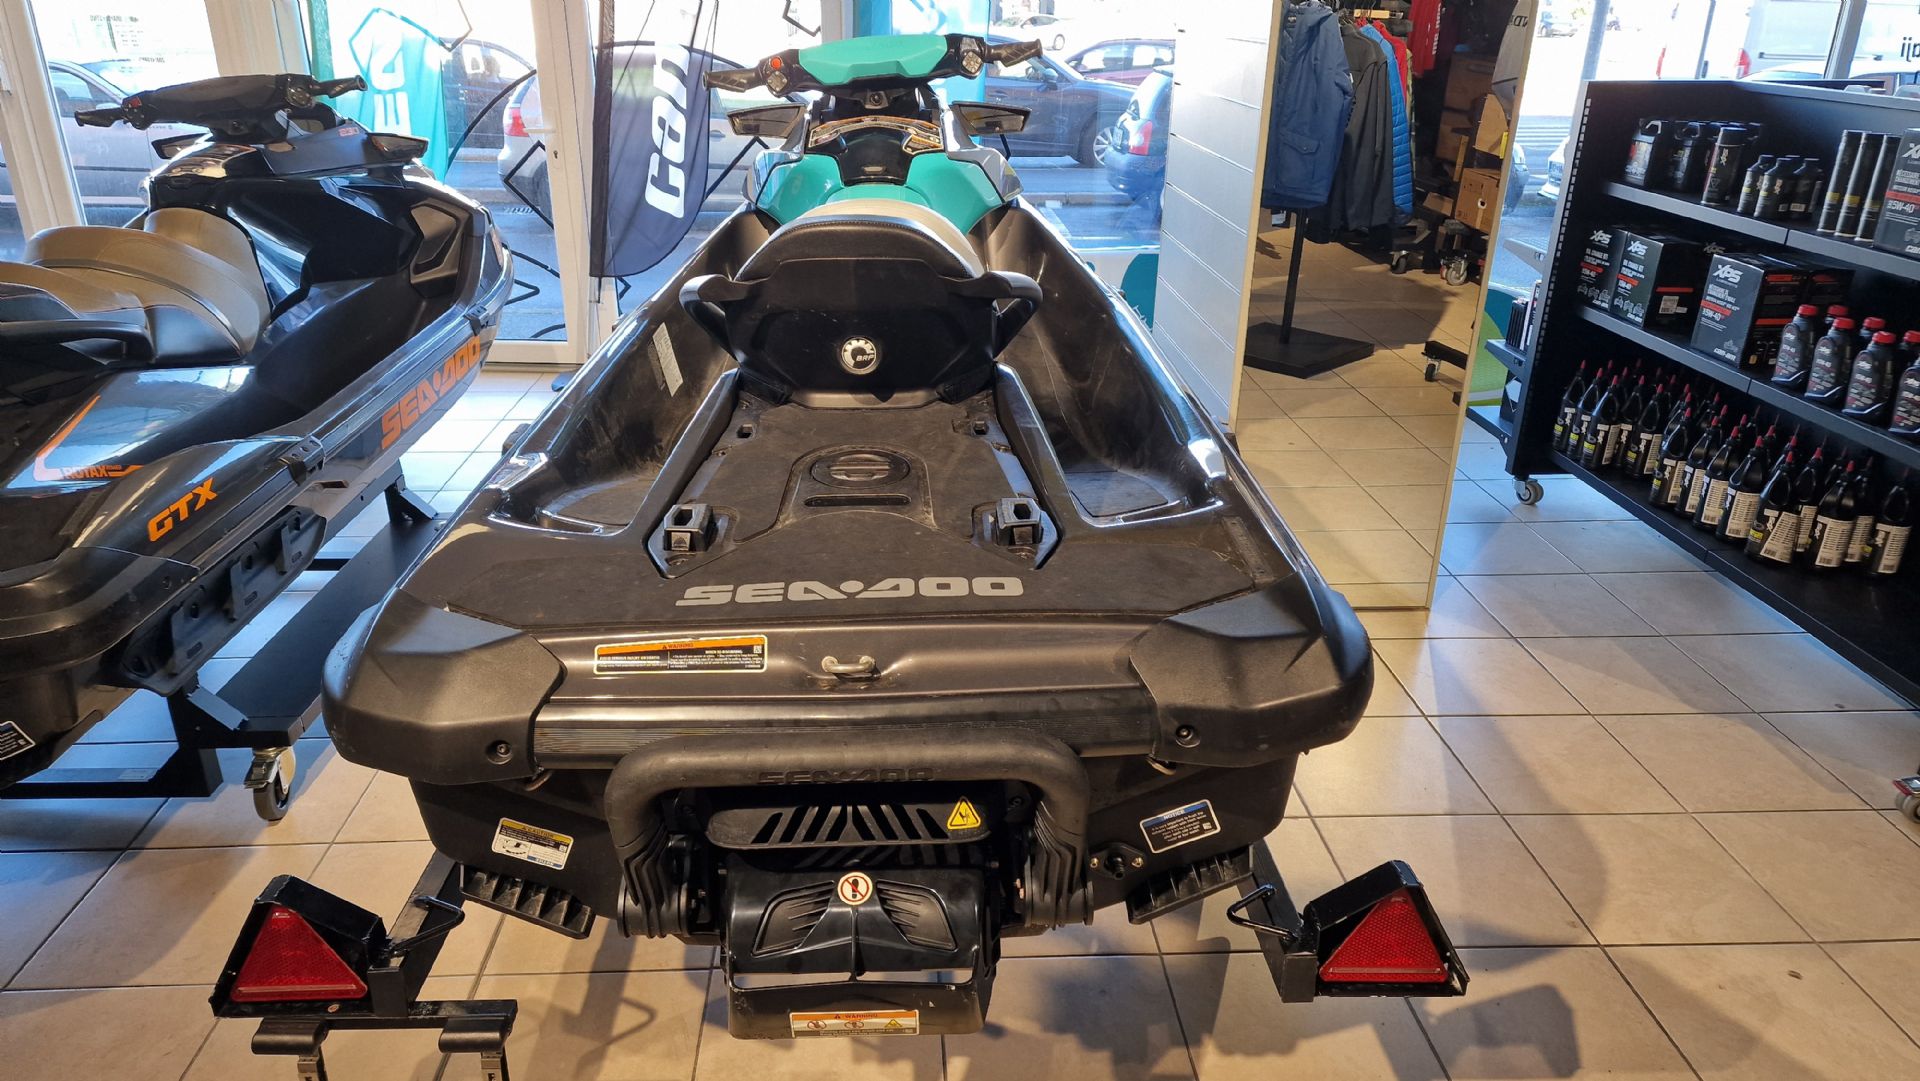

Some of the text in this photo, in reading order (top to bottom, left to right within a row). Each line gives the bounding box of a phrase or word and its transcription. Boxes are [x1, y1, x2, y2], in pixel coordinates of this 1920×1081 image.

[1589, 230, 1612, 245] XPS
[1627, 240, 1649, 256] XPS
[1713, 264, 1744, 283] XPS
[856, 354, 874, 362] BRP
[61, 465, 107, 480] ROTAX
[148, 478, 218, 542] GTX
